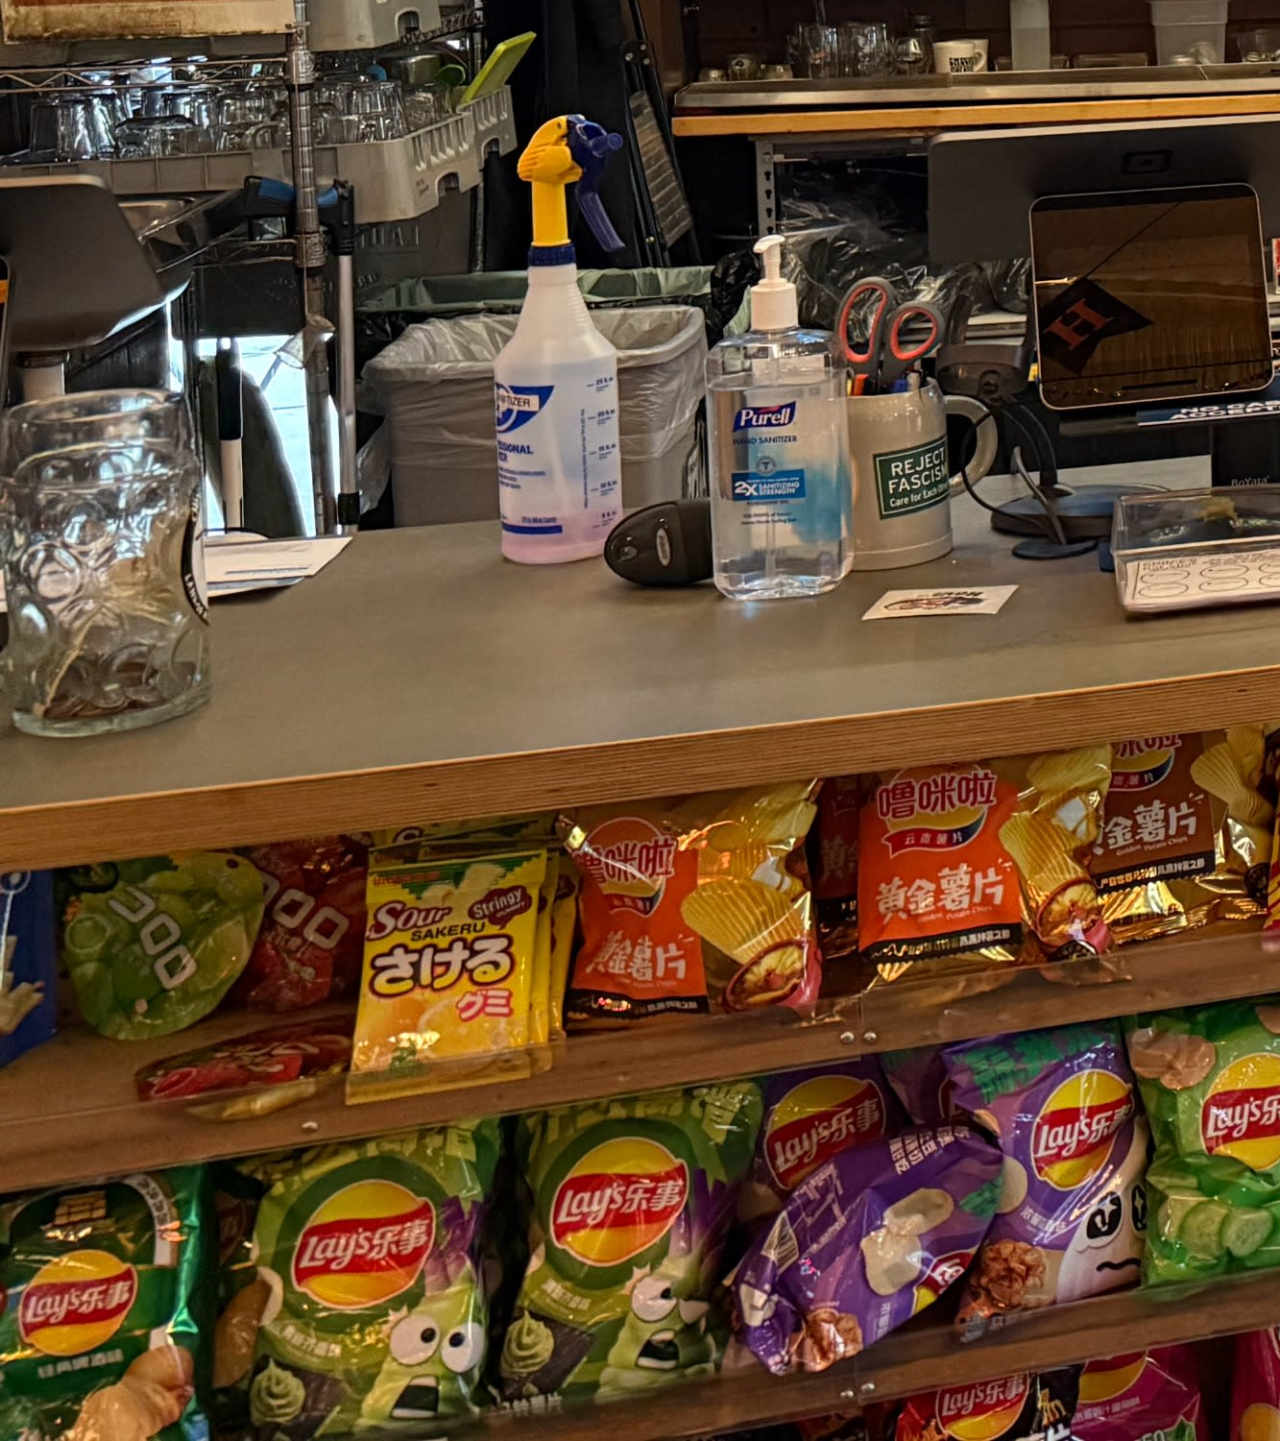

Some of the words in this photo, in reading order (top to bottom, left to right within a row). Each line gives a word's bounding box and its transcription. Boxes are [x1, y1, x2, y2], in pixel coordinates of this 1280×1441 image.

[740, 407, 790, 427] Purell
[891, 447, 946, 476] REJECT
[890, 496, 910, 508] Care
[911, 493, 922, 503] for
[877, 768, 997, 820] 噜咪啦
[473, 888, 522, 918] Stringy
[875, 863, 1006, 923] 黄金薯片
[366, 900, 453, 942] Sour
[411, 922, 486, 942] SAKERU
[369, 934, 514, 999] さける
[456, 988, 513, 1022] グミ
